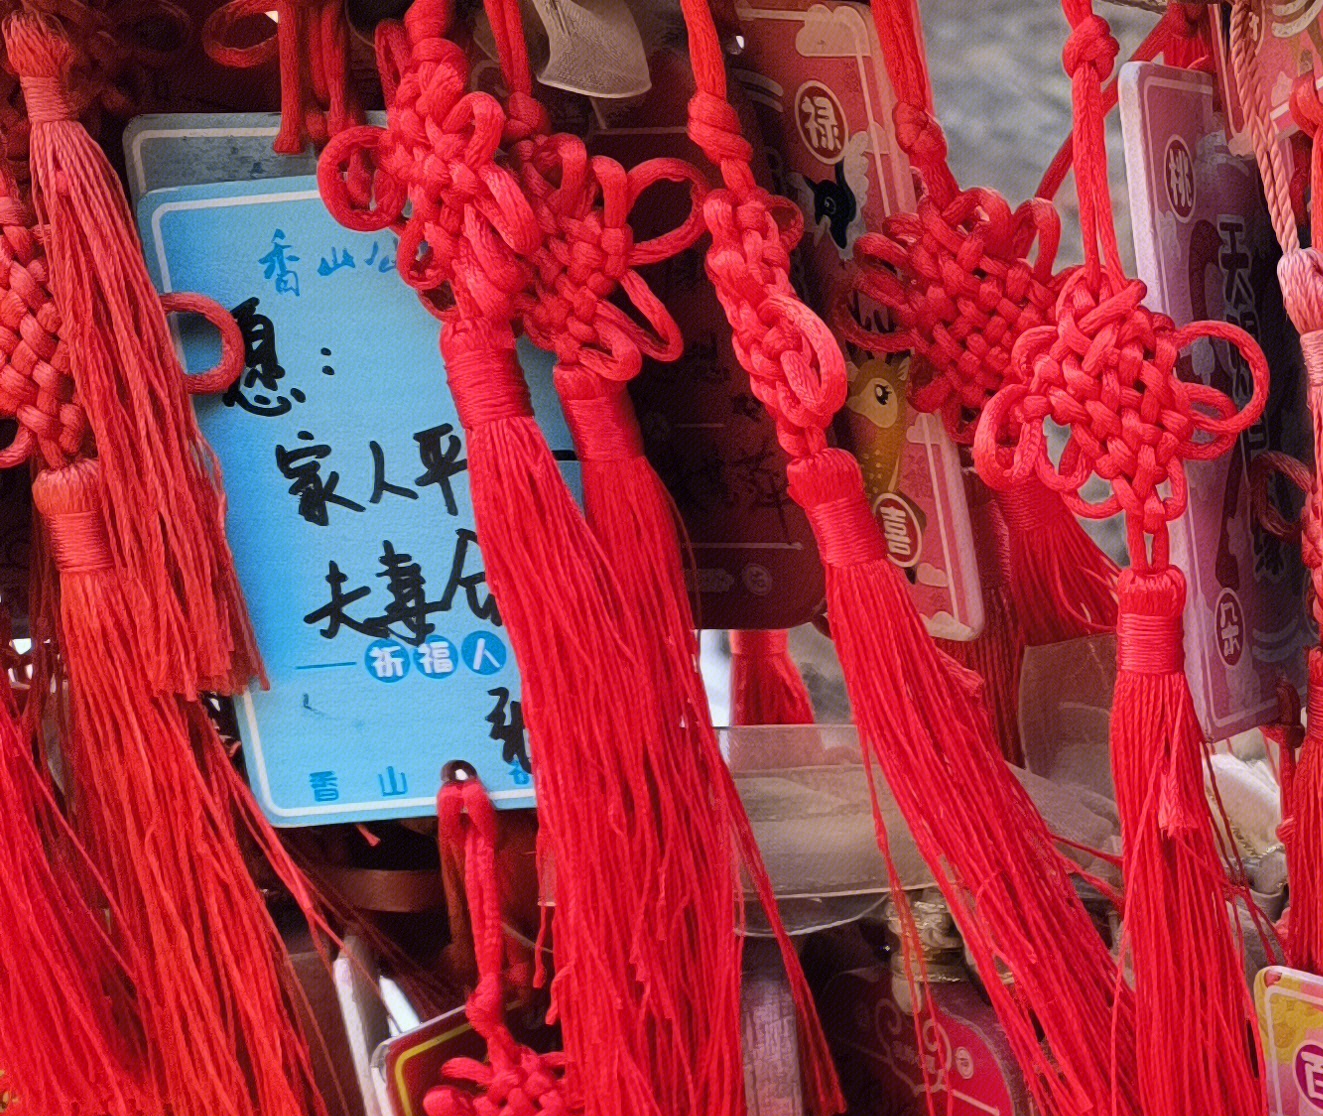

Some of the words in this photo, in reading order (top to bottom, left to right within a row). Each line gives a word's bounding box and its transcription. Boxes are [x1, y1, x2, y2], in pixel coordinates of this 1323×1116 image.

[801, 95, 841, 152] 禄
[366, 633, 504, 681] 祈福人
[309, 765, 408, 802] 香山
